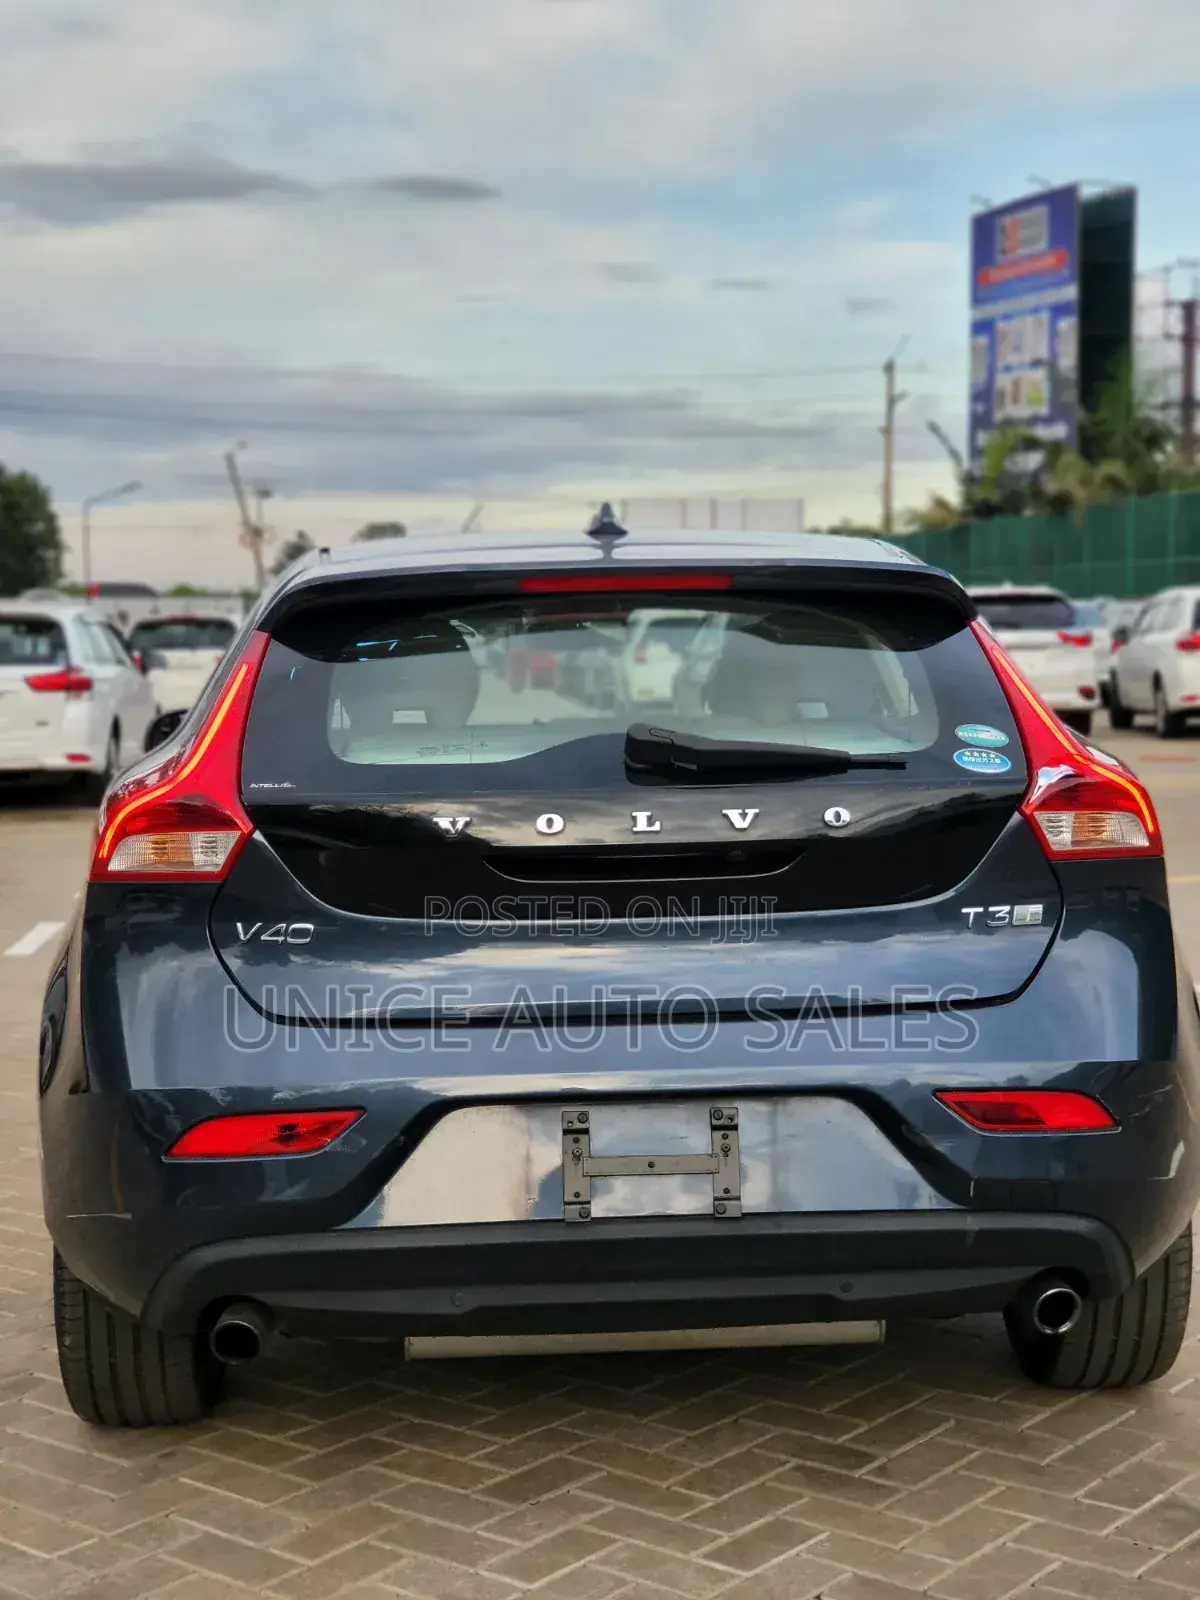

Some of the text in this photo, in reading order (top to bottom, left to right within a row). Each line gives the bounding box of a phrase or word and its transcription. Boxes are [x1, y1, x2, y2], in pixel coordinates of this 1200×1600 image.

[432, 806, 851, 837] VOLVO
[961, 905, 1011, 928] T3
[236, 922, 315, 944] V40
